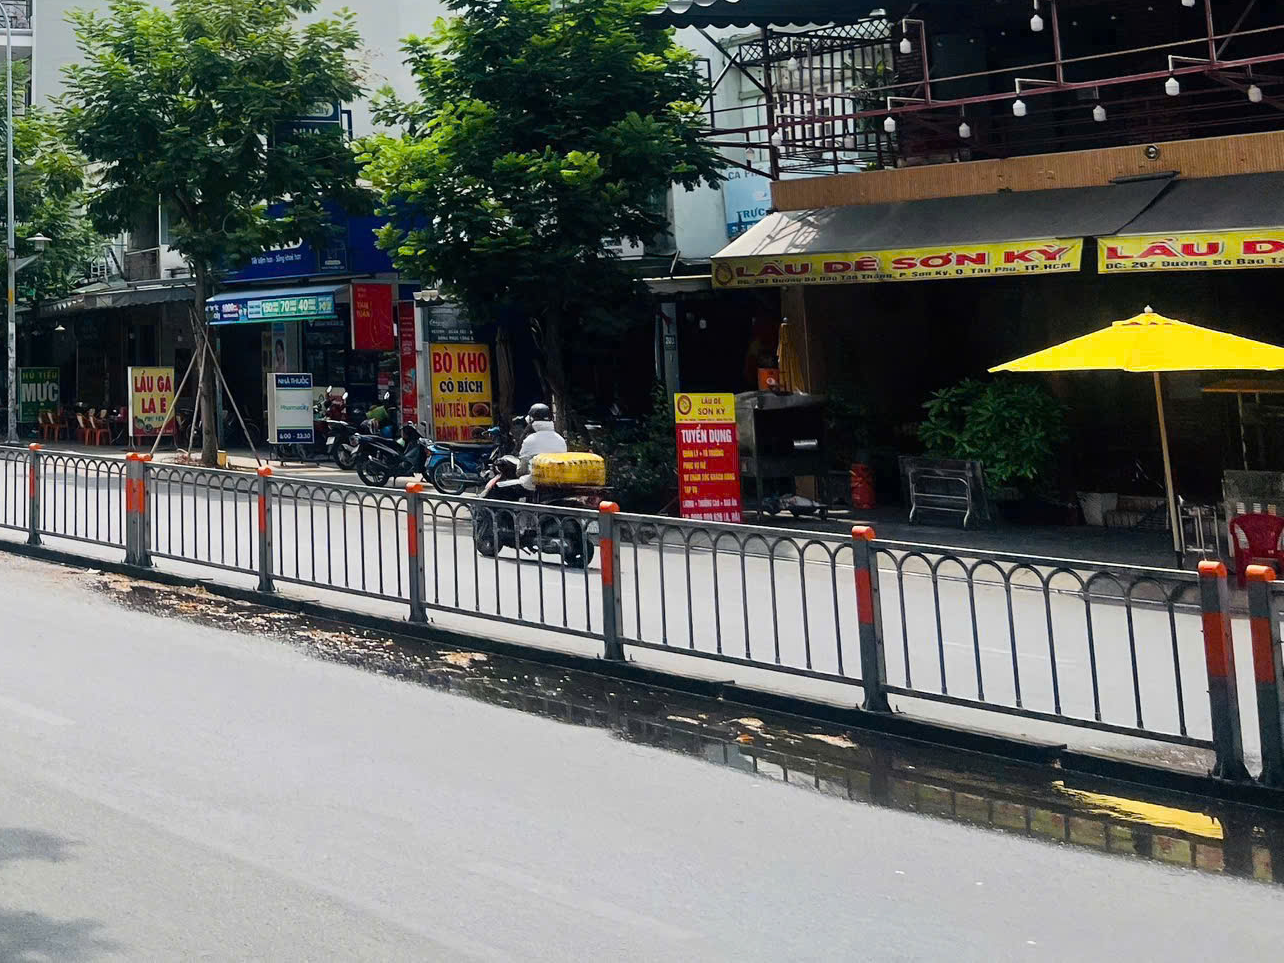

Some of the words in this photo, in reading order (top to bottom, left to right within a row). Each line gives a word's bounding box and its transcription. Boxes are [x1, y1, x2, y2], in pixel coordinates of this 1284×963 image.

[824, 256, 878, 274] DÊ
[891, 252, 987, 270] SƠN
[1003, 244, 1073, 264] KỲ
[280, 300, 290, 312] 70
[298, 299, 308, 311] 40
[433, 346, 452, 373] BÒ
[457, 351, 488, 374] KHO
[21, 380, 59, 406] MỰC
[134, 370, 154, 393] LẨU
[157, 372, 172, 393] GÀ
[439, 377, 454, 393] CÔ
[457, 376, 484, 393] BÍCH
[141, 394, 156, 414] LÁ
[681, 423, 708, 444] TUYỂN
[709, 428, 732, 446] DỤNG
